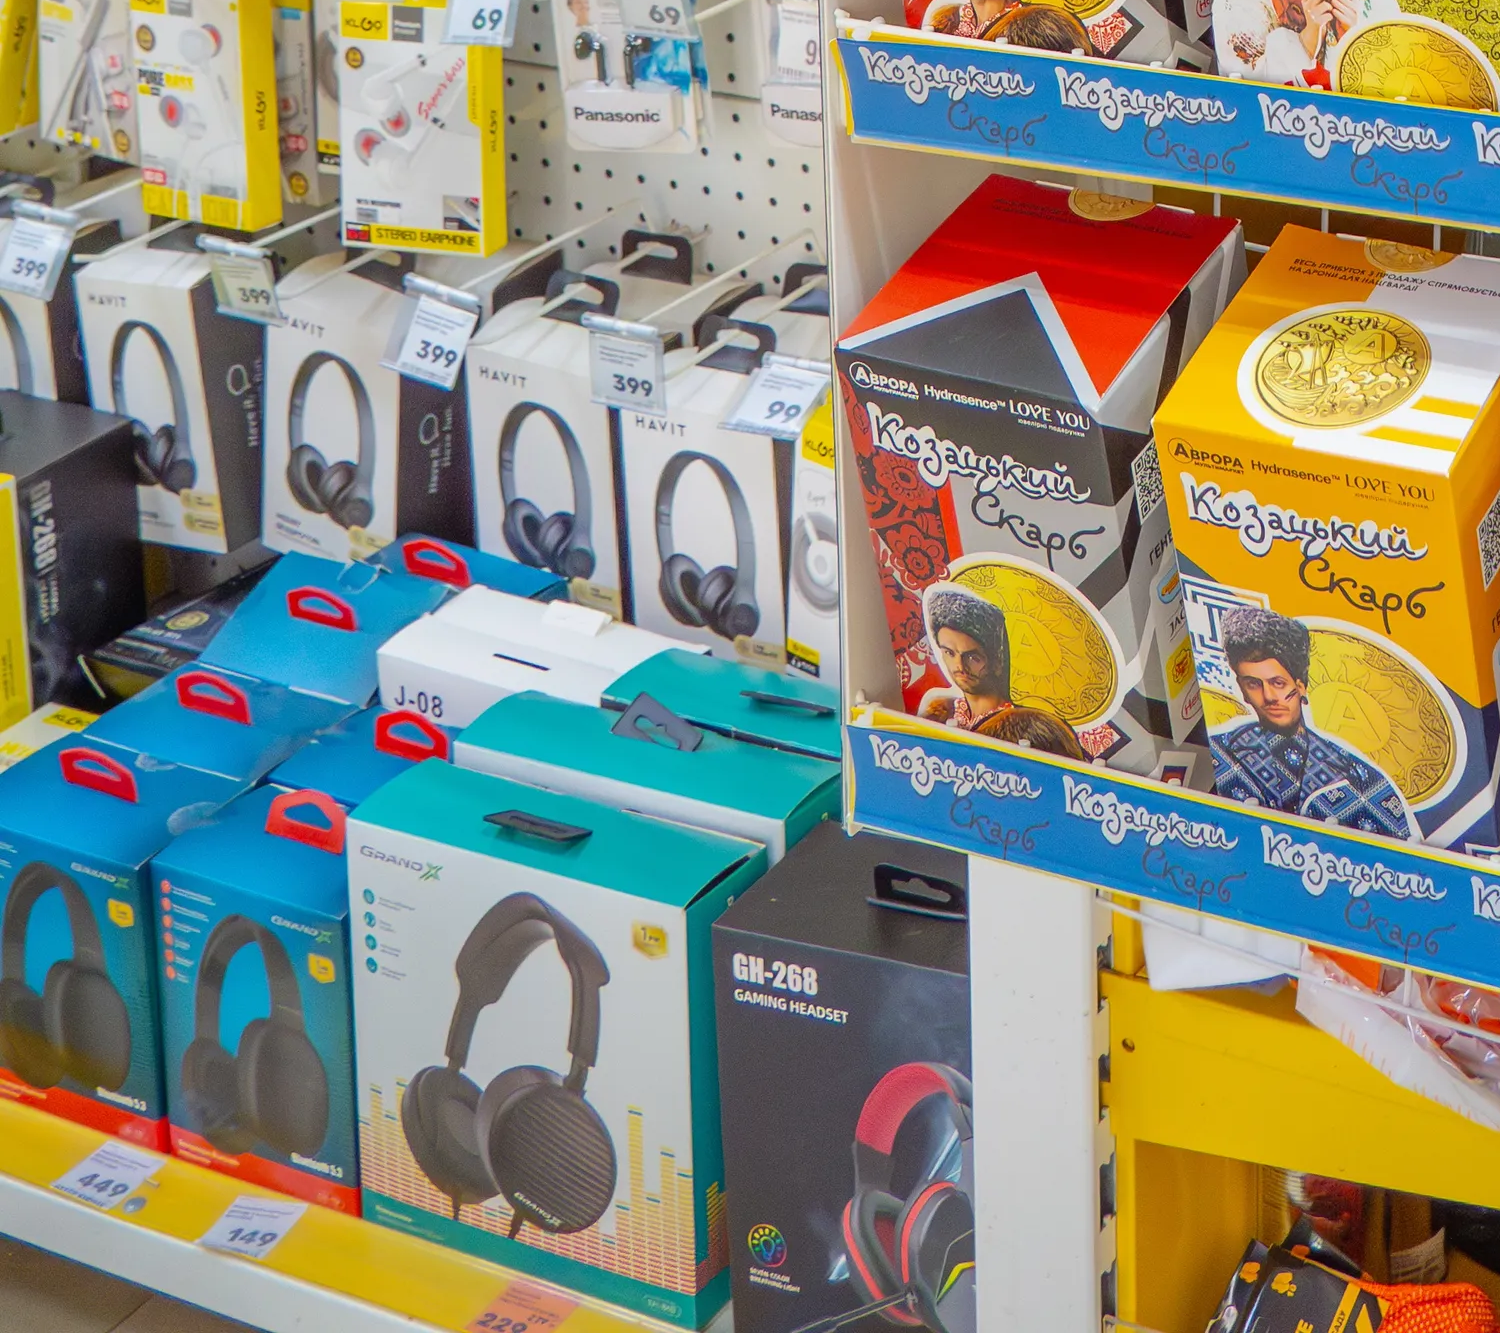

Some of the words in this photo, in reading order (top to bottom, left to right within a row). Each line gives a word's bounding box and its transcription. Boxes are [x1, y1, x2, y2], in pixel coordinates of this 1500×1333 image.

[471, 8, 503, 31] 69
[648, 4, 681, 26] 69
[574, 106, 661, 124] Panasonic
[859, 46, 1036, 105] Козацький
[1055, 66, 1237, 131] Козацький
[1257, 93, 1451, 159] Козацький
[947, 99, 1048, 157] Скарб
[1142, 126, 1249, 184] Скарб
[1351, 153, 1463, 215] Скарб
[12, 257, 49, 280] 399
[1318, 262, 1367, 277] ПРИБУТОК
[1376, 271, 1427, 286] ПРОДАЖУ
[237, 287, 271, 306] 399
[415, 339, 458, 369] 399
[478, 365, 528, 390] HAVIT
[612, 374, 655, 398] 399
[634, 414, 687, 438] HAVIT
[766, 400, 802, 425] 99
[1009, 400, 1052, 423] LOVE
[1056, 407, 1091, 432] YOU
[865, 401, 1091, 503] Козацький
[1345, 476, 1392, 496] LOVE
[1397, 481, 1436, 503] YOU
[1179, 471, 1428, 561] Козацький
[971, 491, 1106, 573] Скарб
[1298, 554, 1446, 635] Скарб
[393, 684, 444, 720] J-08
[869, 734, 1042, 797] Козацький
[1062, 775, 1239, 851] Козацький
[1260, 825, 1447, 900] Козацький
[950, 797, 1050, 859] Скарб
[1141, 844, 1246, 911] Скарб
[1343, 896, 1456, 963] Скарб
[733, 952, 818, 996] GH-268
[734, 989, 787, 1011] GAMING
[789, 1001, 849, 1024] HEADSET
[77, 1171, 130, 1198] 449
[228, 1223, 278, 1248] 149
